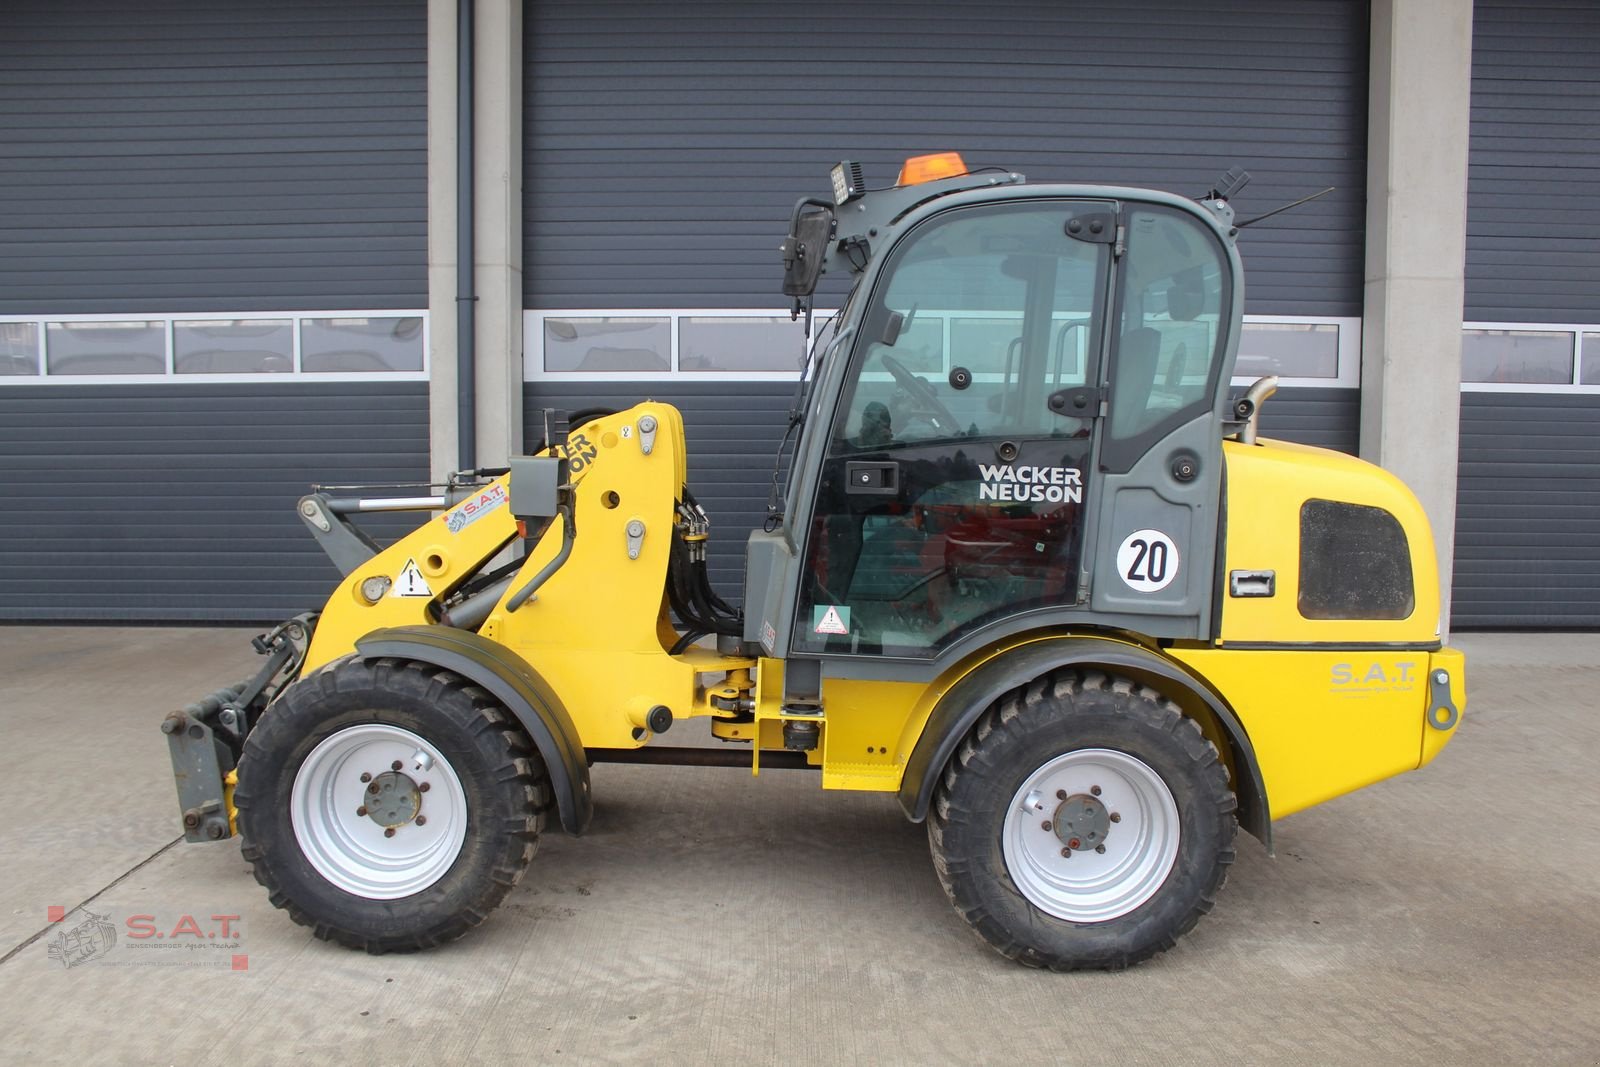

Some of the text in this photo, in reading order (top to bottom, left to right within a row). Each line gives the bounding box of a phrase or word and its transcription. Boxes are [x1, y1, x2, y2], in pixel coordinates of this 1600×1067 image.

[979, 464, 1082, 485] WACKER
[464, 486, 504, 515] S.A.T.
[980, 483, 1082, 503] NEUSON
[1127, 538, 1168, 583] 20
[1331, 662, 1415, 684] S.A.T.
